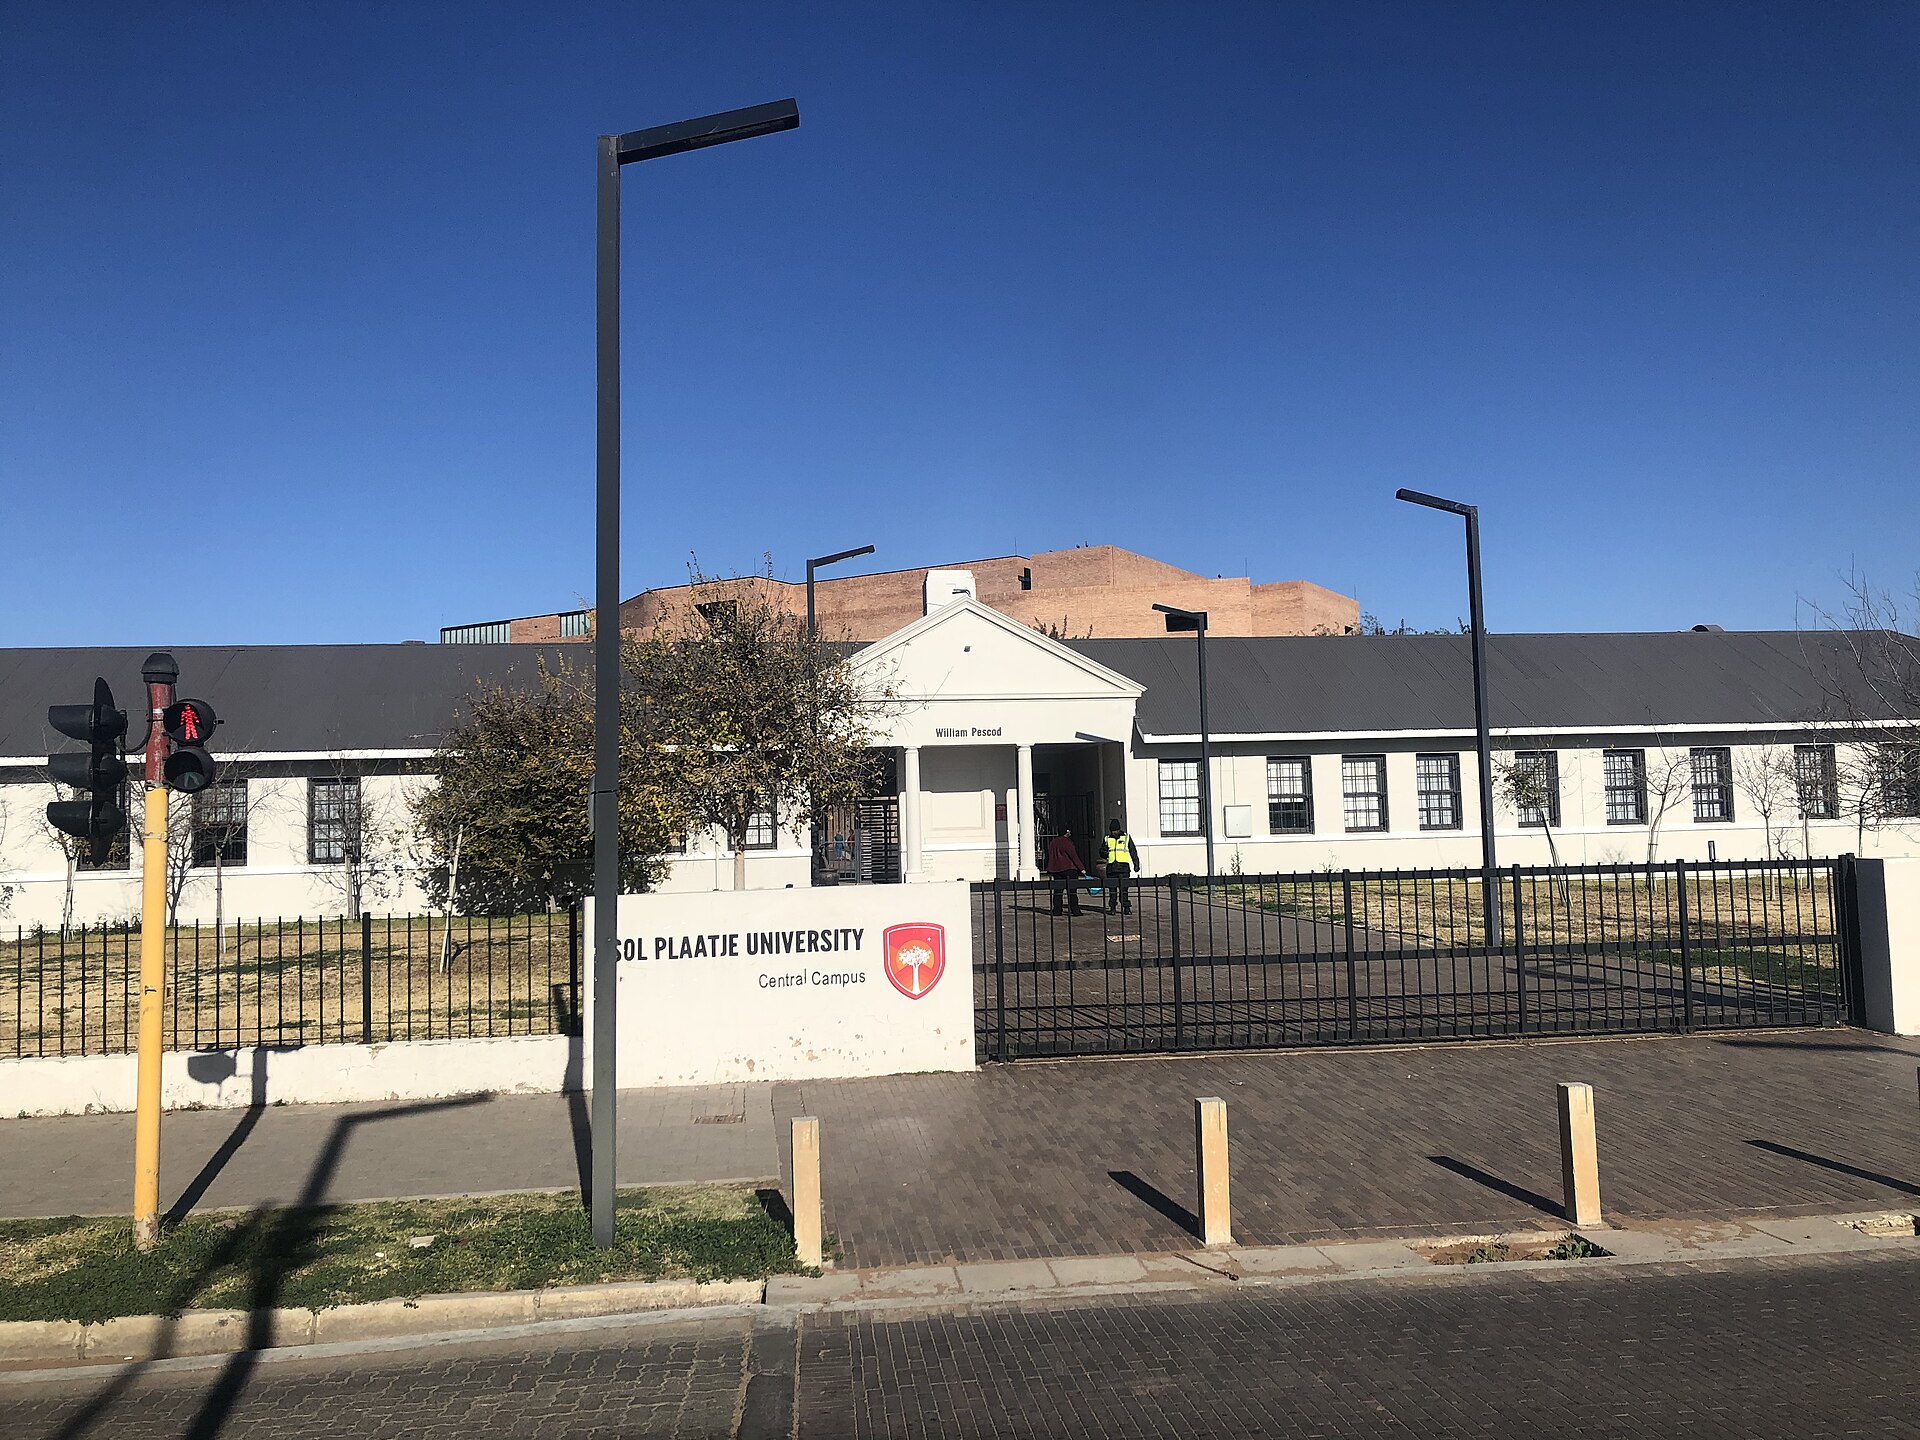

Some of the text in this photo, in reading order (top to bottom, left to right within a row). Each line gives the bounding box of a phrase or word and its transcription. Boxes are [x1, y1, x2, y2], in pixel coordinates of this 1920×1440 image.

[935, 726, 1002, 738] William Pescod
[654, 933, 739, 960] PLAATJE
[746, 928, 865, 956] UNIVERSITY
[758, 968, 866, 989] Central Campus
